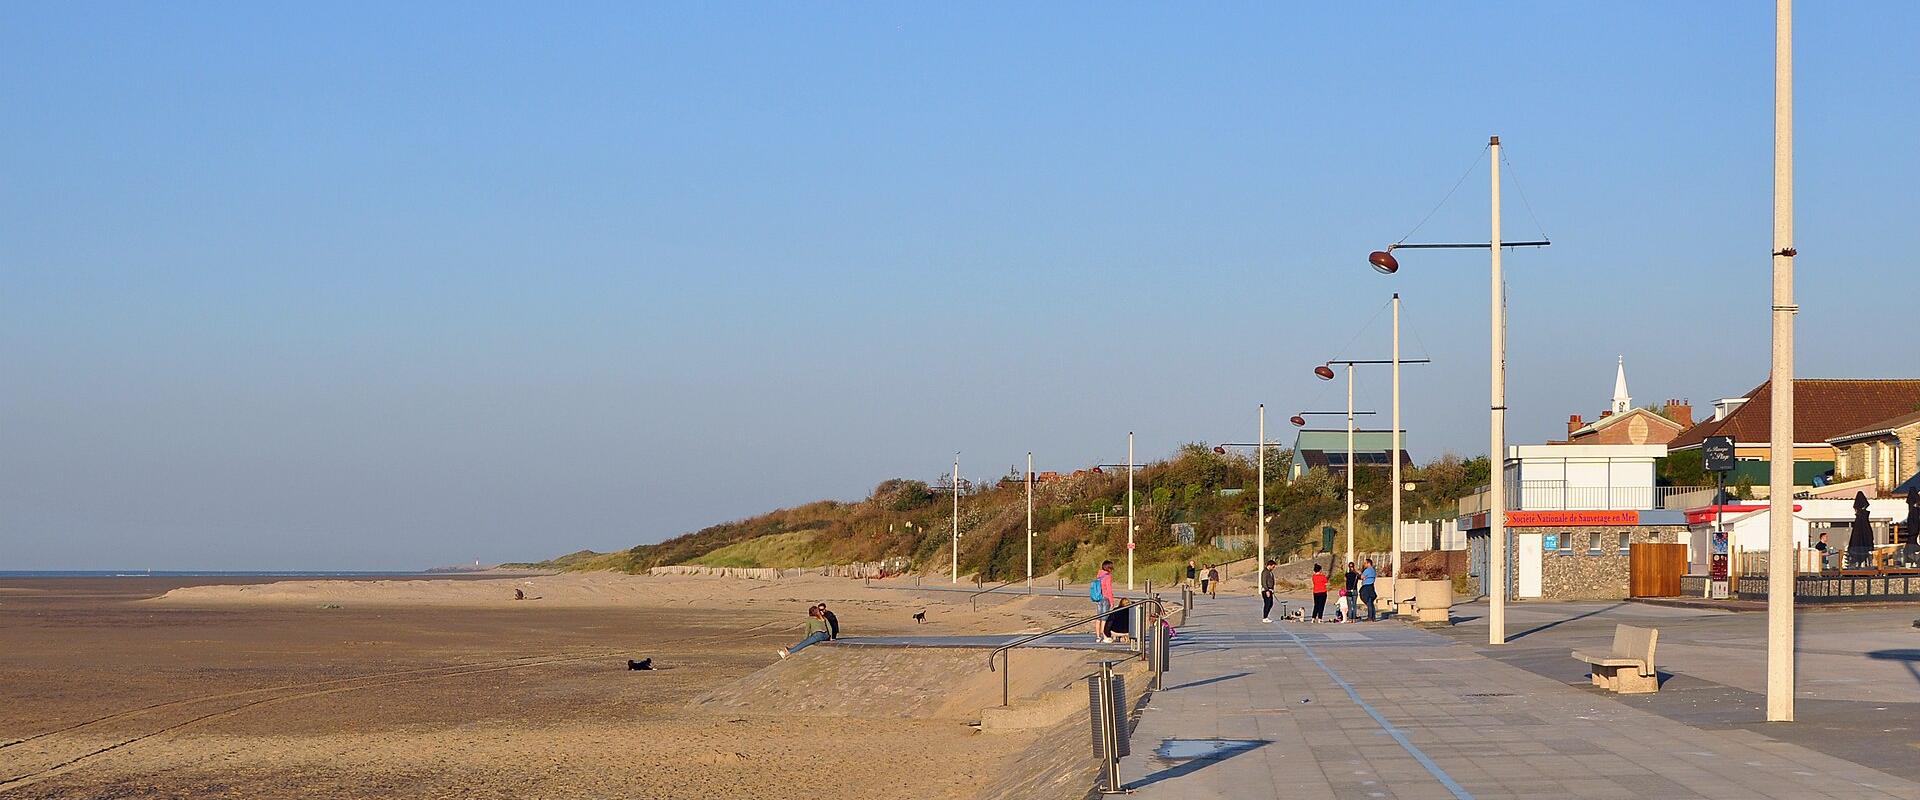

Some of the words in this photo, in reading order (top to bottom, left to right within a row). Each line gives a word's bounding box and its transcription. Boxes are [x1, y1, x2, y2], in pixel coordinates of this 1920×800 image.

[1536, 513, 1568, 523] Nationale
[1569, 512, 1578, 522] de
[1578, 513, 1610, 525] Sauvetage
[1621, 512, 1636, 522] Mer
